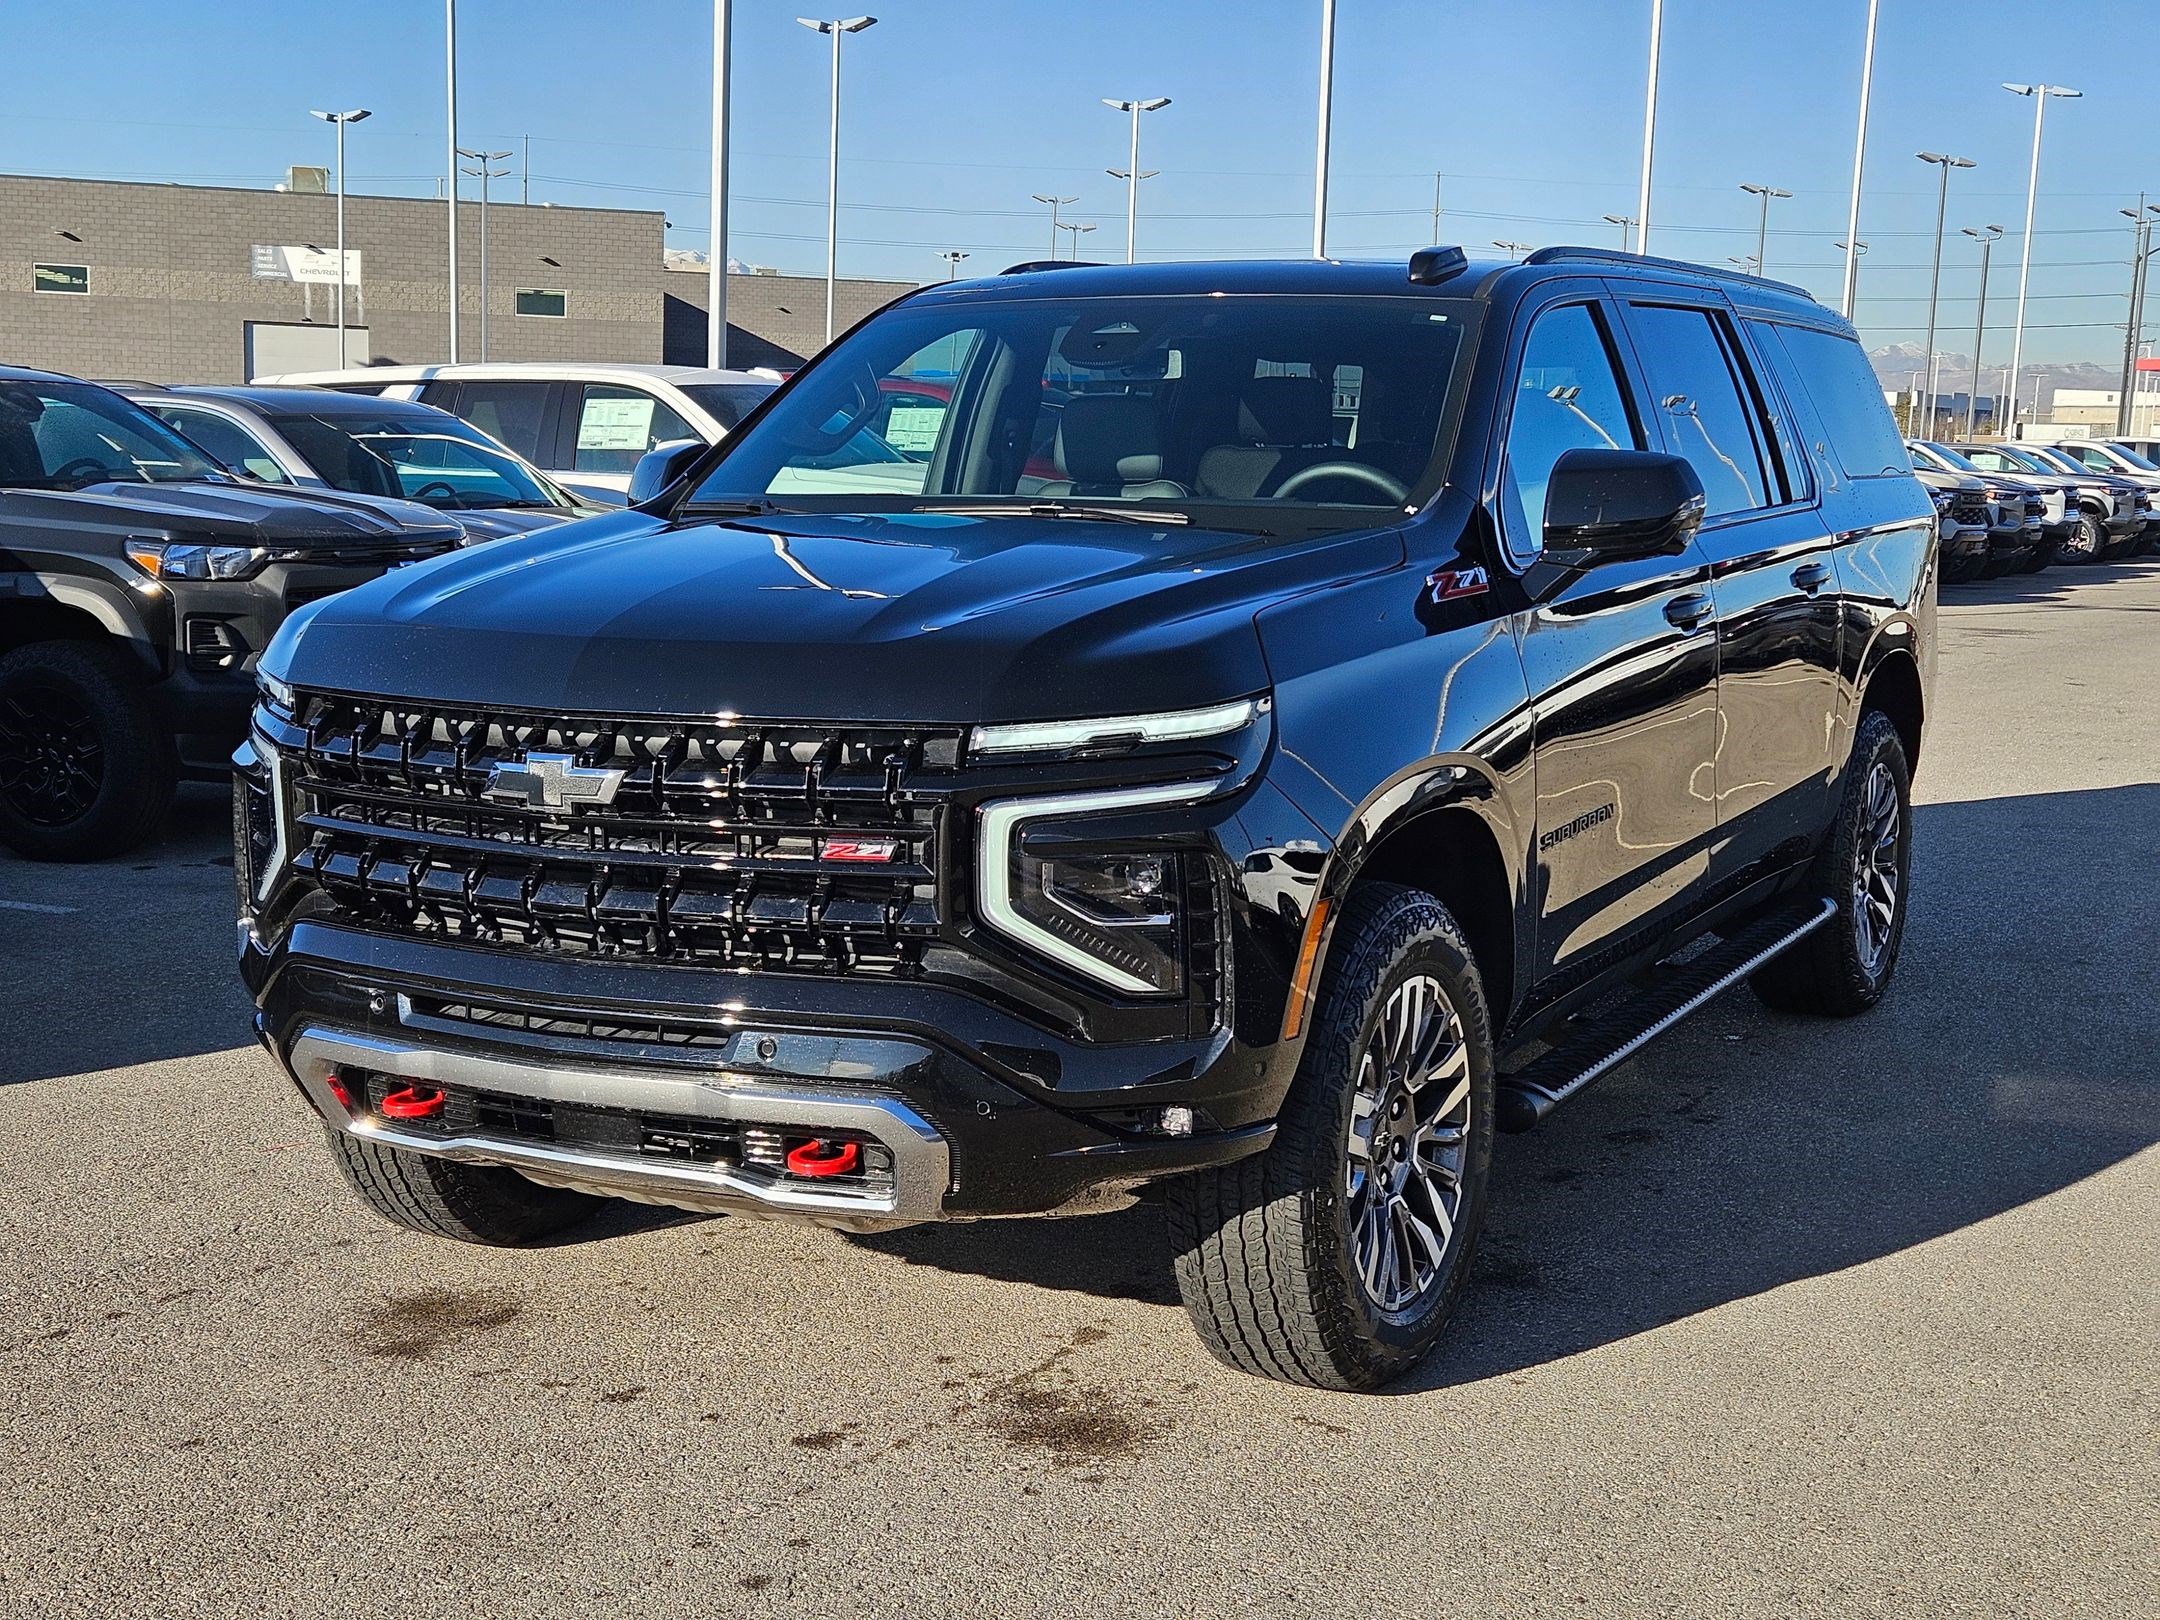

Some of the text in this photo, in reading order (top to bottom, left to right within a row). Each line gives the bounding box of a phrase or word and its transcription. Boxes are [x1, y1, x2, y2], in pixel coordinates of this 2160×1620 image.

[300, 268, 351, 277] CHEVROLT
[1426, 566, 1490, 604] Z71
[1539, 803, 1615, 852] SUBURBAN
[822, 842, 897, 861] Z71
